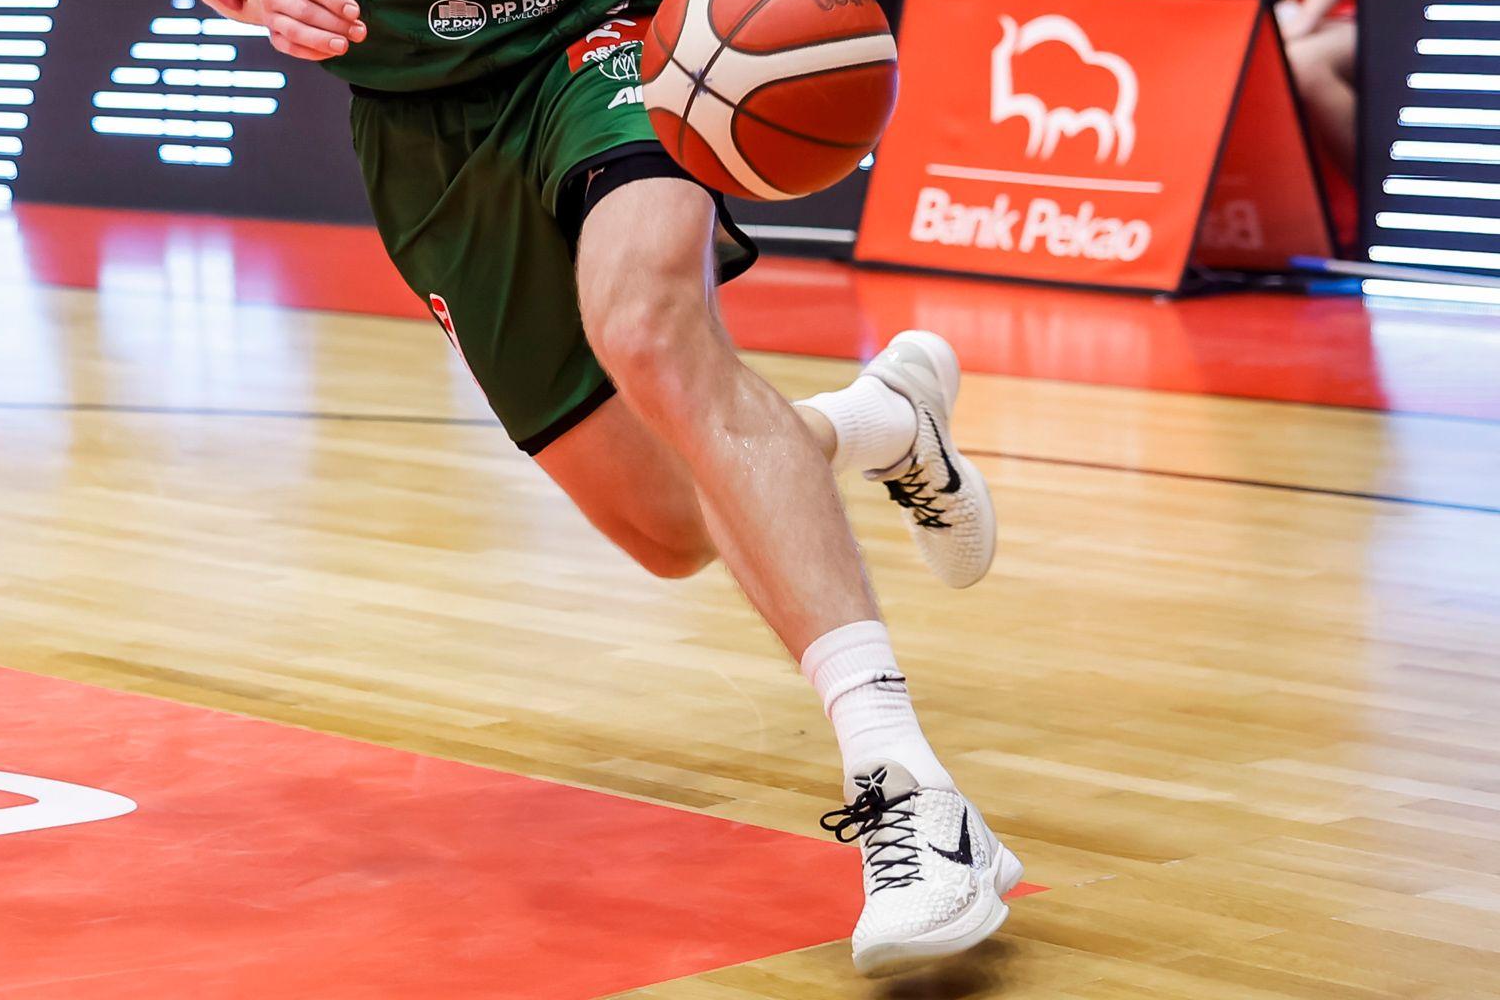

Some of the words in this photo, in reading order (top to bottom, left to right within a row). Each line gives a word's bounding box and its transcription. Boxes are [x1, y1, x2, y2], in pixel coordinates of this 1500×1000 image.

[491, 0, 517, 19] PP
[433, 19, 450, 29] PP
[453, 18, 483, 28] DOM
[909, 186, 1022, 252] Bank
[1017, 198, 1154, 264] Pekao
